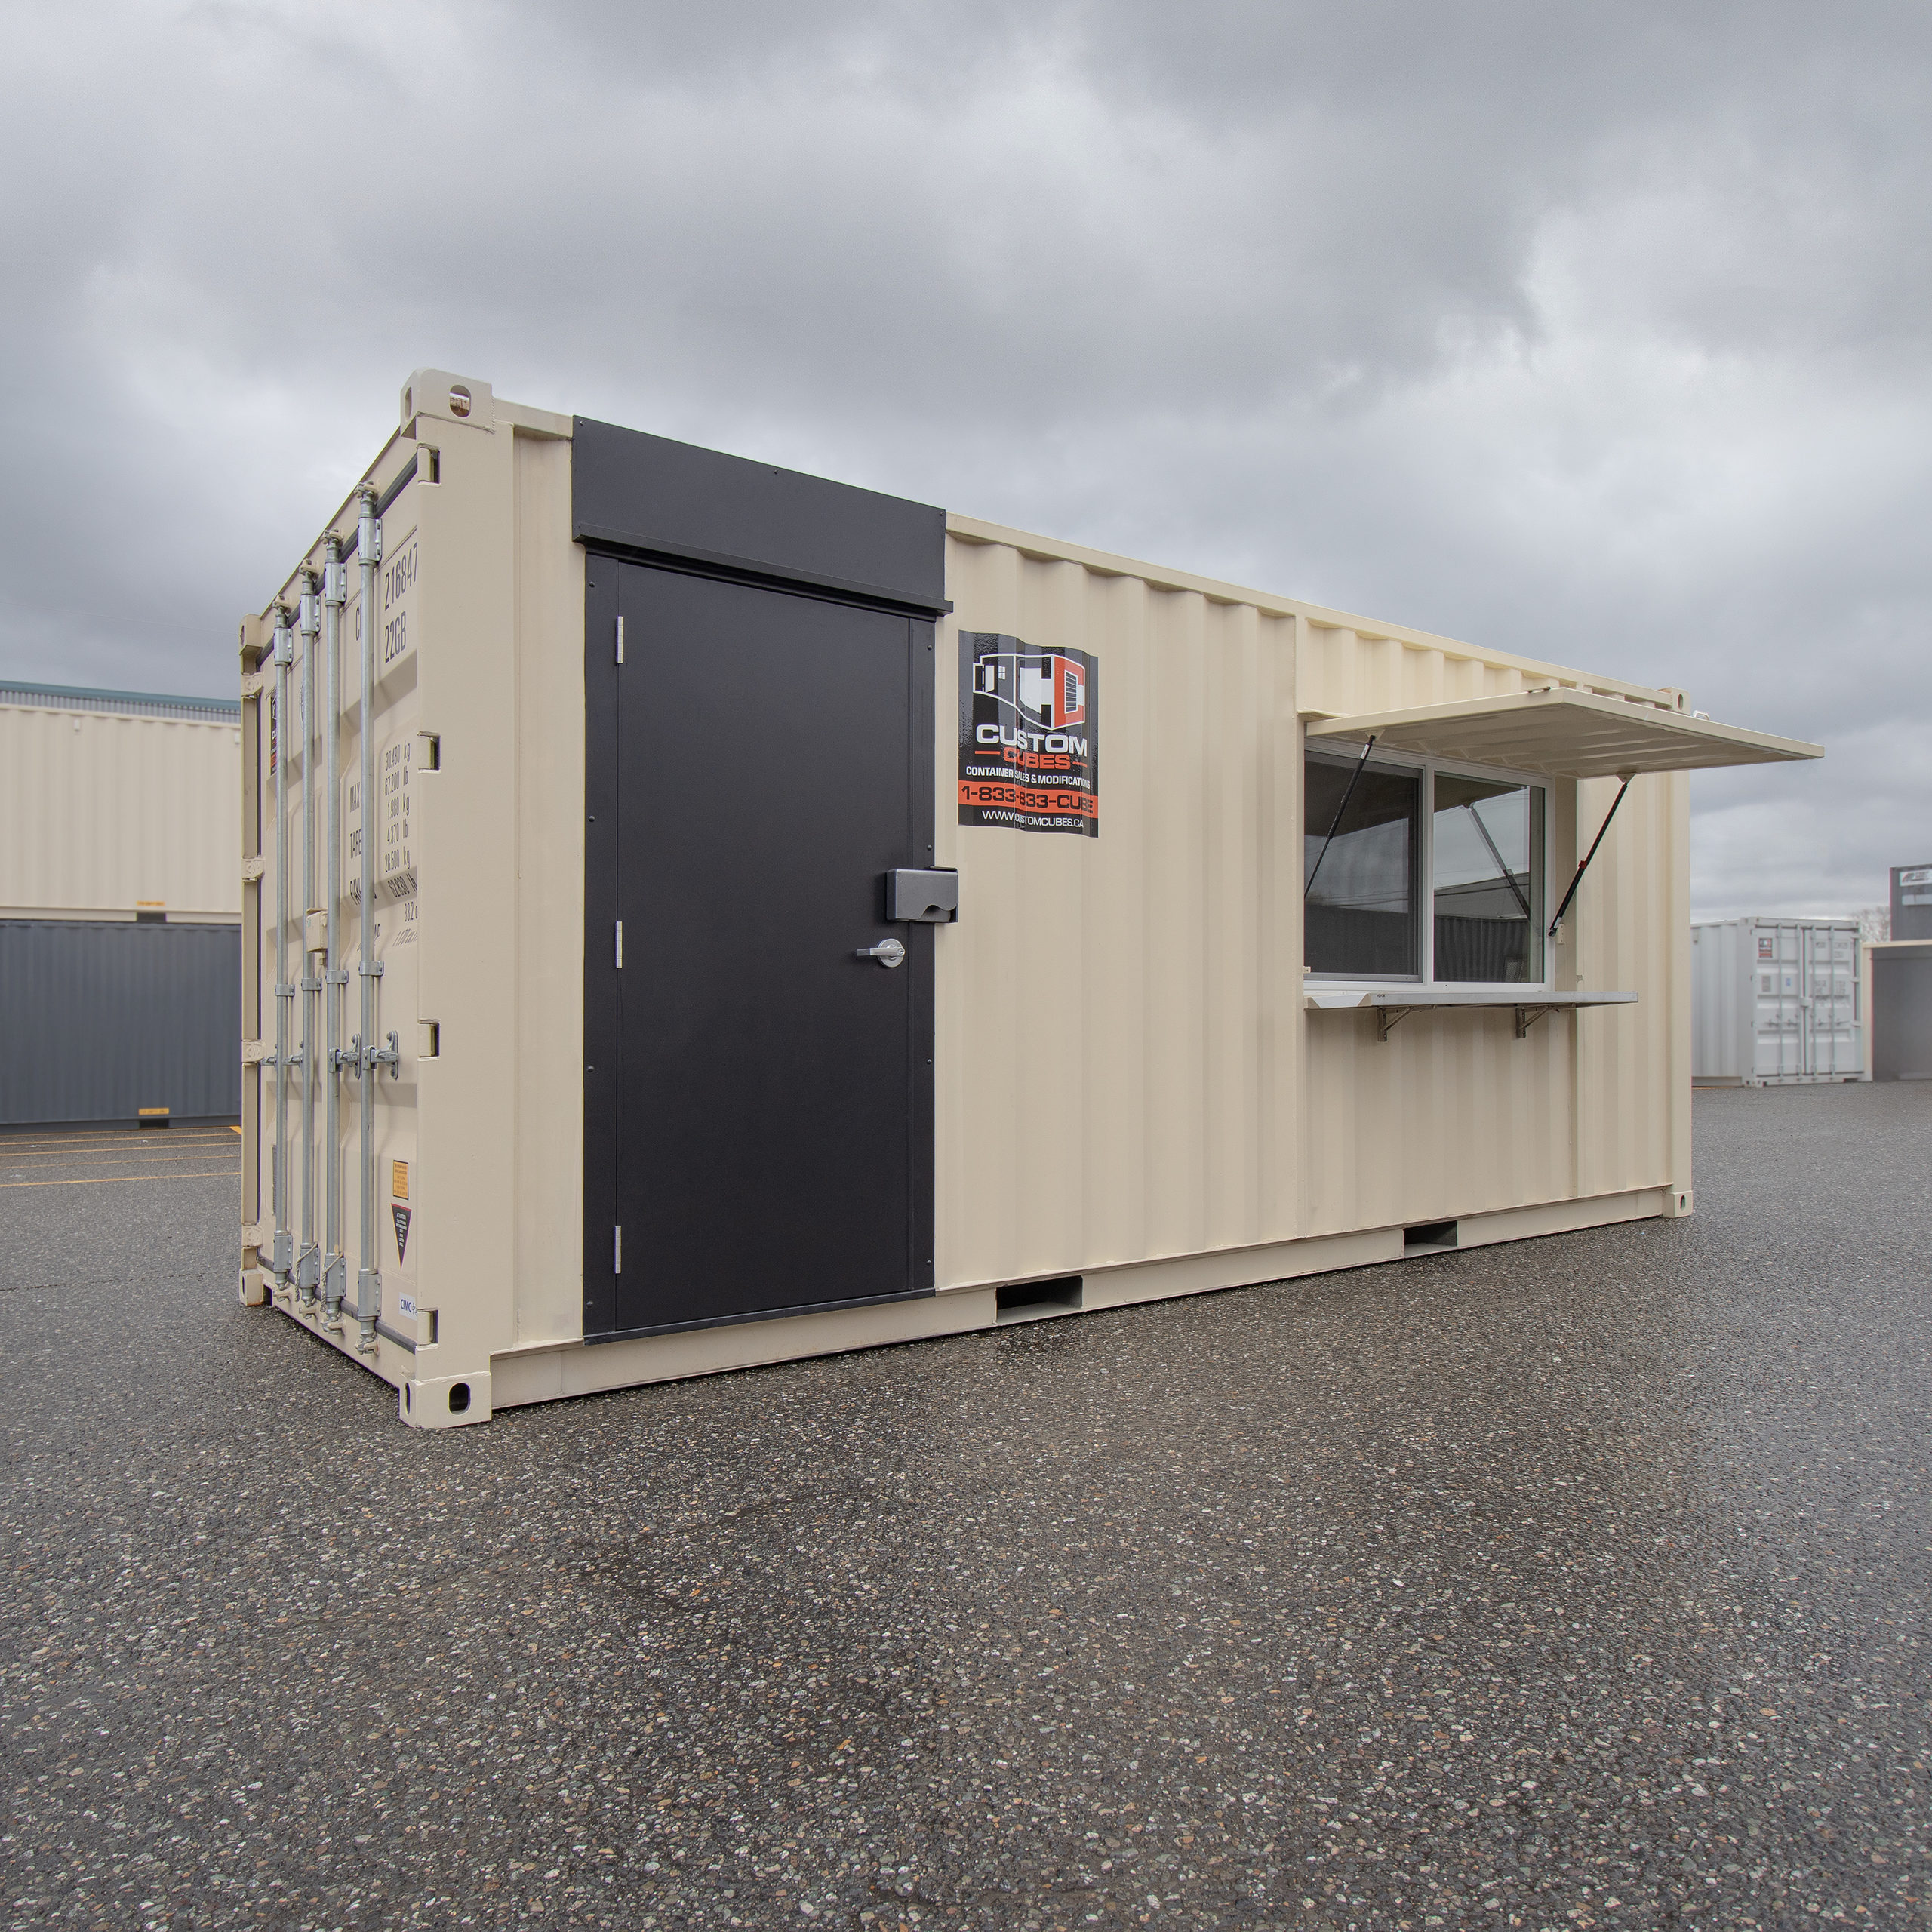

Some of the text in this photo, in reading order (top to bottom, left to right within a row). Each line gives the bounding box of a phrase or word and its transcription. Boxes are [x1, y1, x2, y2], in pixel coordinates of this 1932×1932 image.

[384, 542, 417, 611] 216847
[384, 611, 407, 664] 22GB
[403, 740, 411, 762] kg
[976, 724, 1088, 758] CUSTOM
[1003, 746, 1071, 770] CUBES
[403, 765, 408, 786] lb
[966, 765, 1091, 789] CONTAINER SALES & MODIFICATIONS
[402, 792, 410, 816] kg
[961, 786, 1094, 814] 1-833-833-CUBE
[403, 818, 408, 838] lb
[981, 811, 1084, 828] WWW.CUSTOMCUBES.CA
[403, 845, 411, 869] kg
